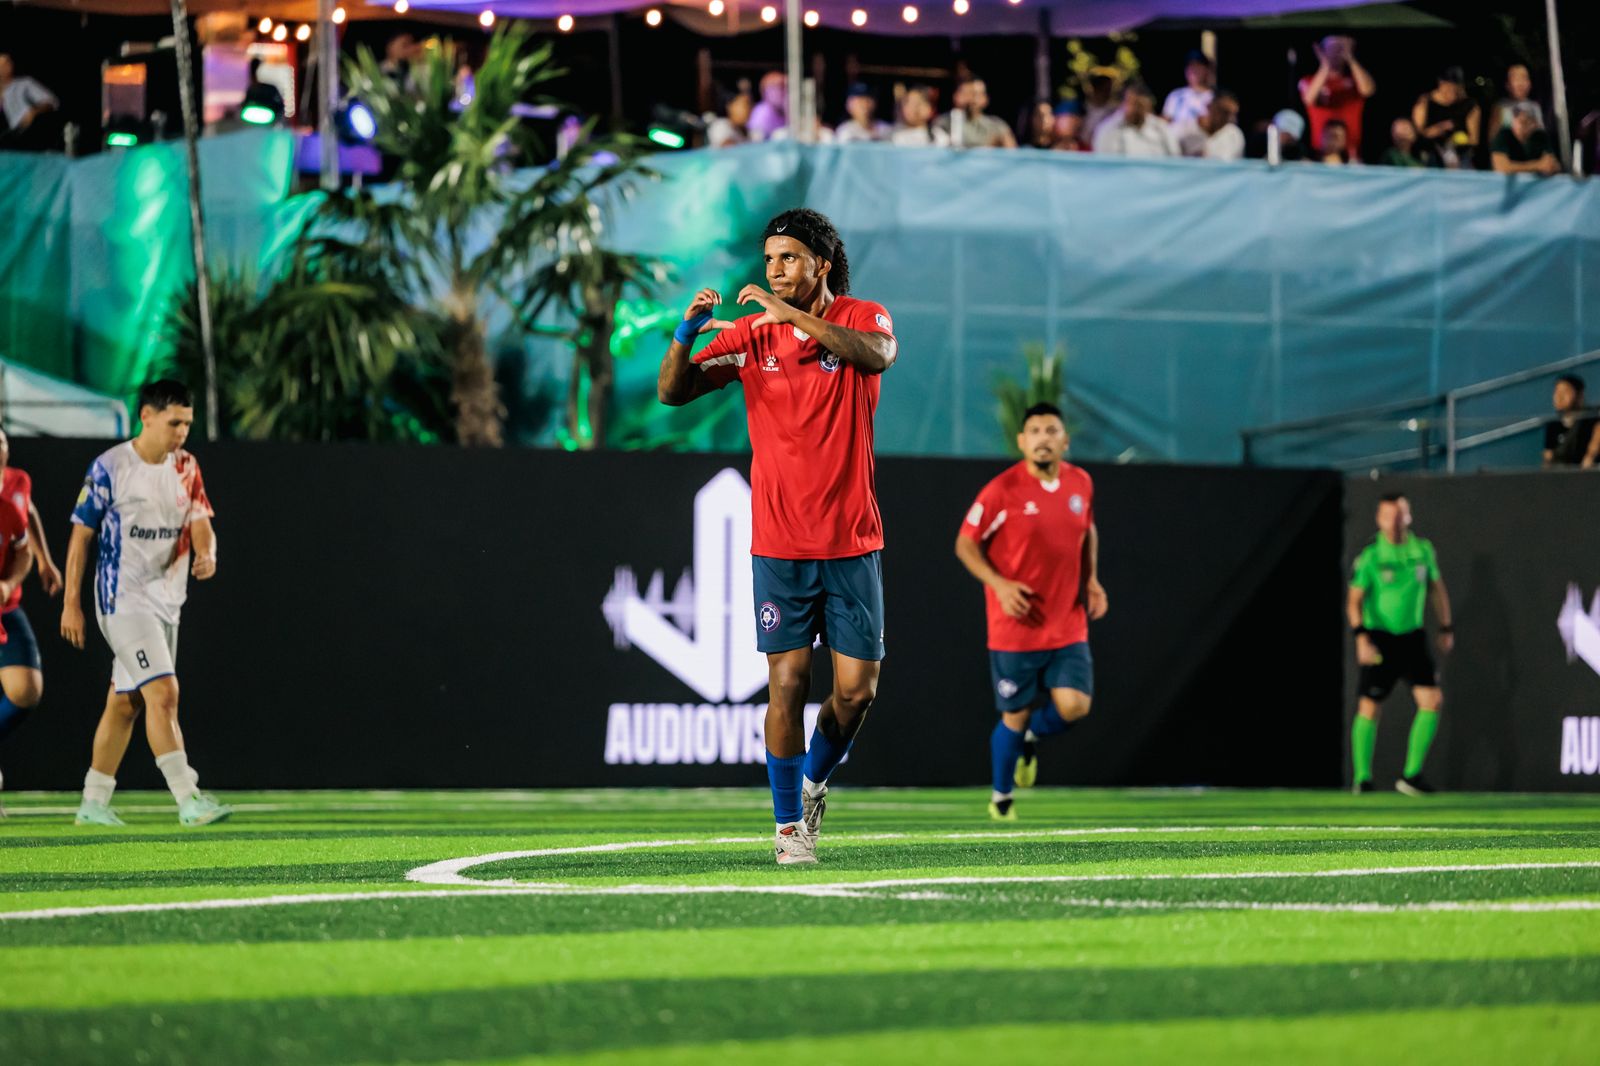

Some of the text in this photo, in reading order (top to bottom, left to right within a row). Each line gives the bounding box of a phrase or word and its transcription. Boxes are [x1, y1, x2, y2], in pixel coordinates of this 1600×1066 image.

[129, 524, 157, 540] Copy
[136, 649, 150, 670] 8
[603, 702, 848, 764] AUDIOVIS
[1560, 715, 1600, 775] AU
